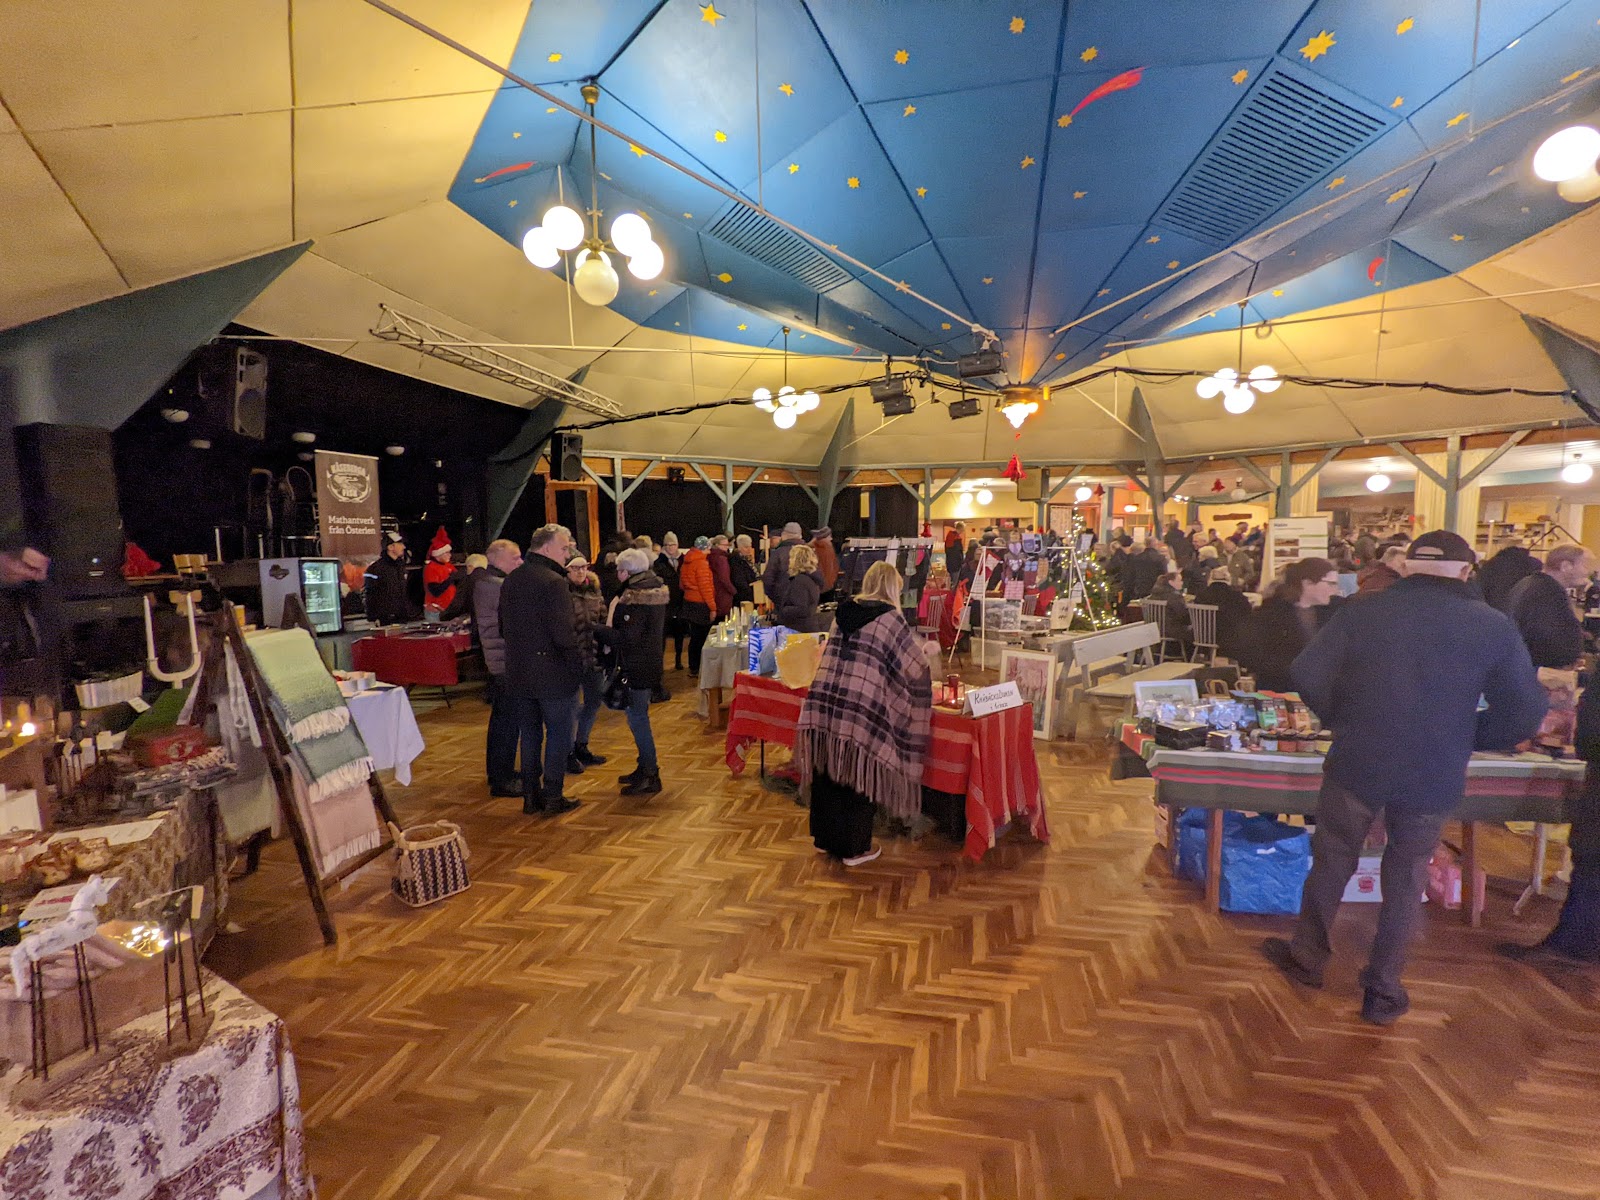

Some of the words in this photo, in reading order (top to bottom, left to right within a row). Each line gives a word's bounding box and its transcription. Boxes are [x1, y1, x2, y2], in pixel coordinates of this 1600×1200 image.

[328, 515, 375, 524] Mathantverk
[328, 525, 345, 534] från
[345, 525, 376, 534] Österlen
